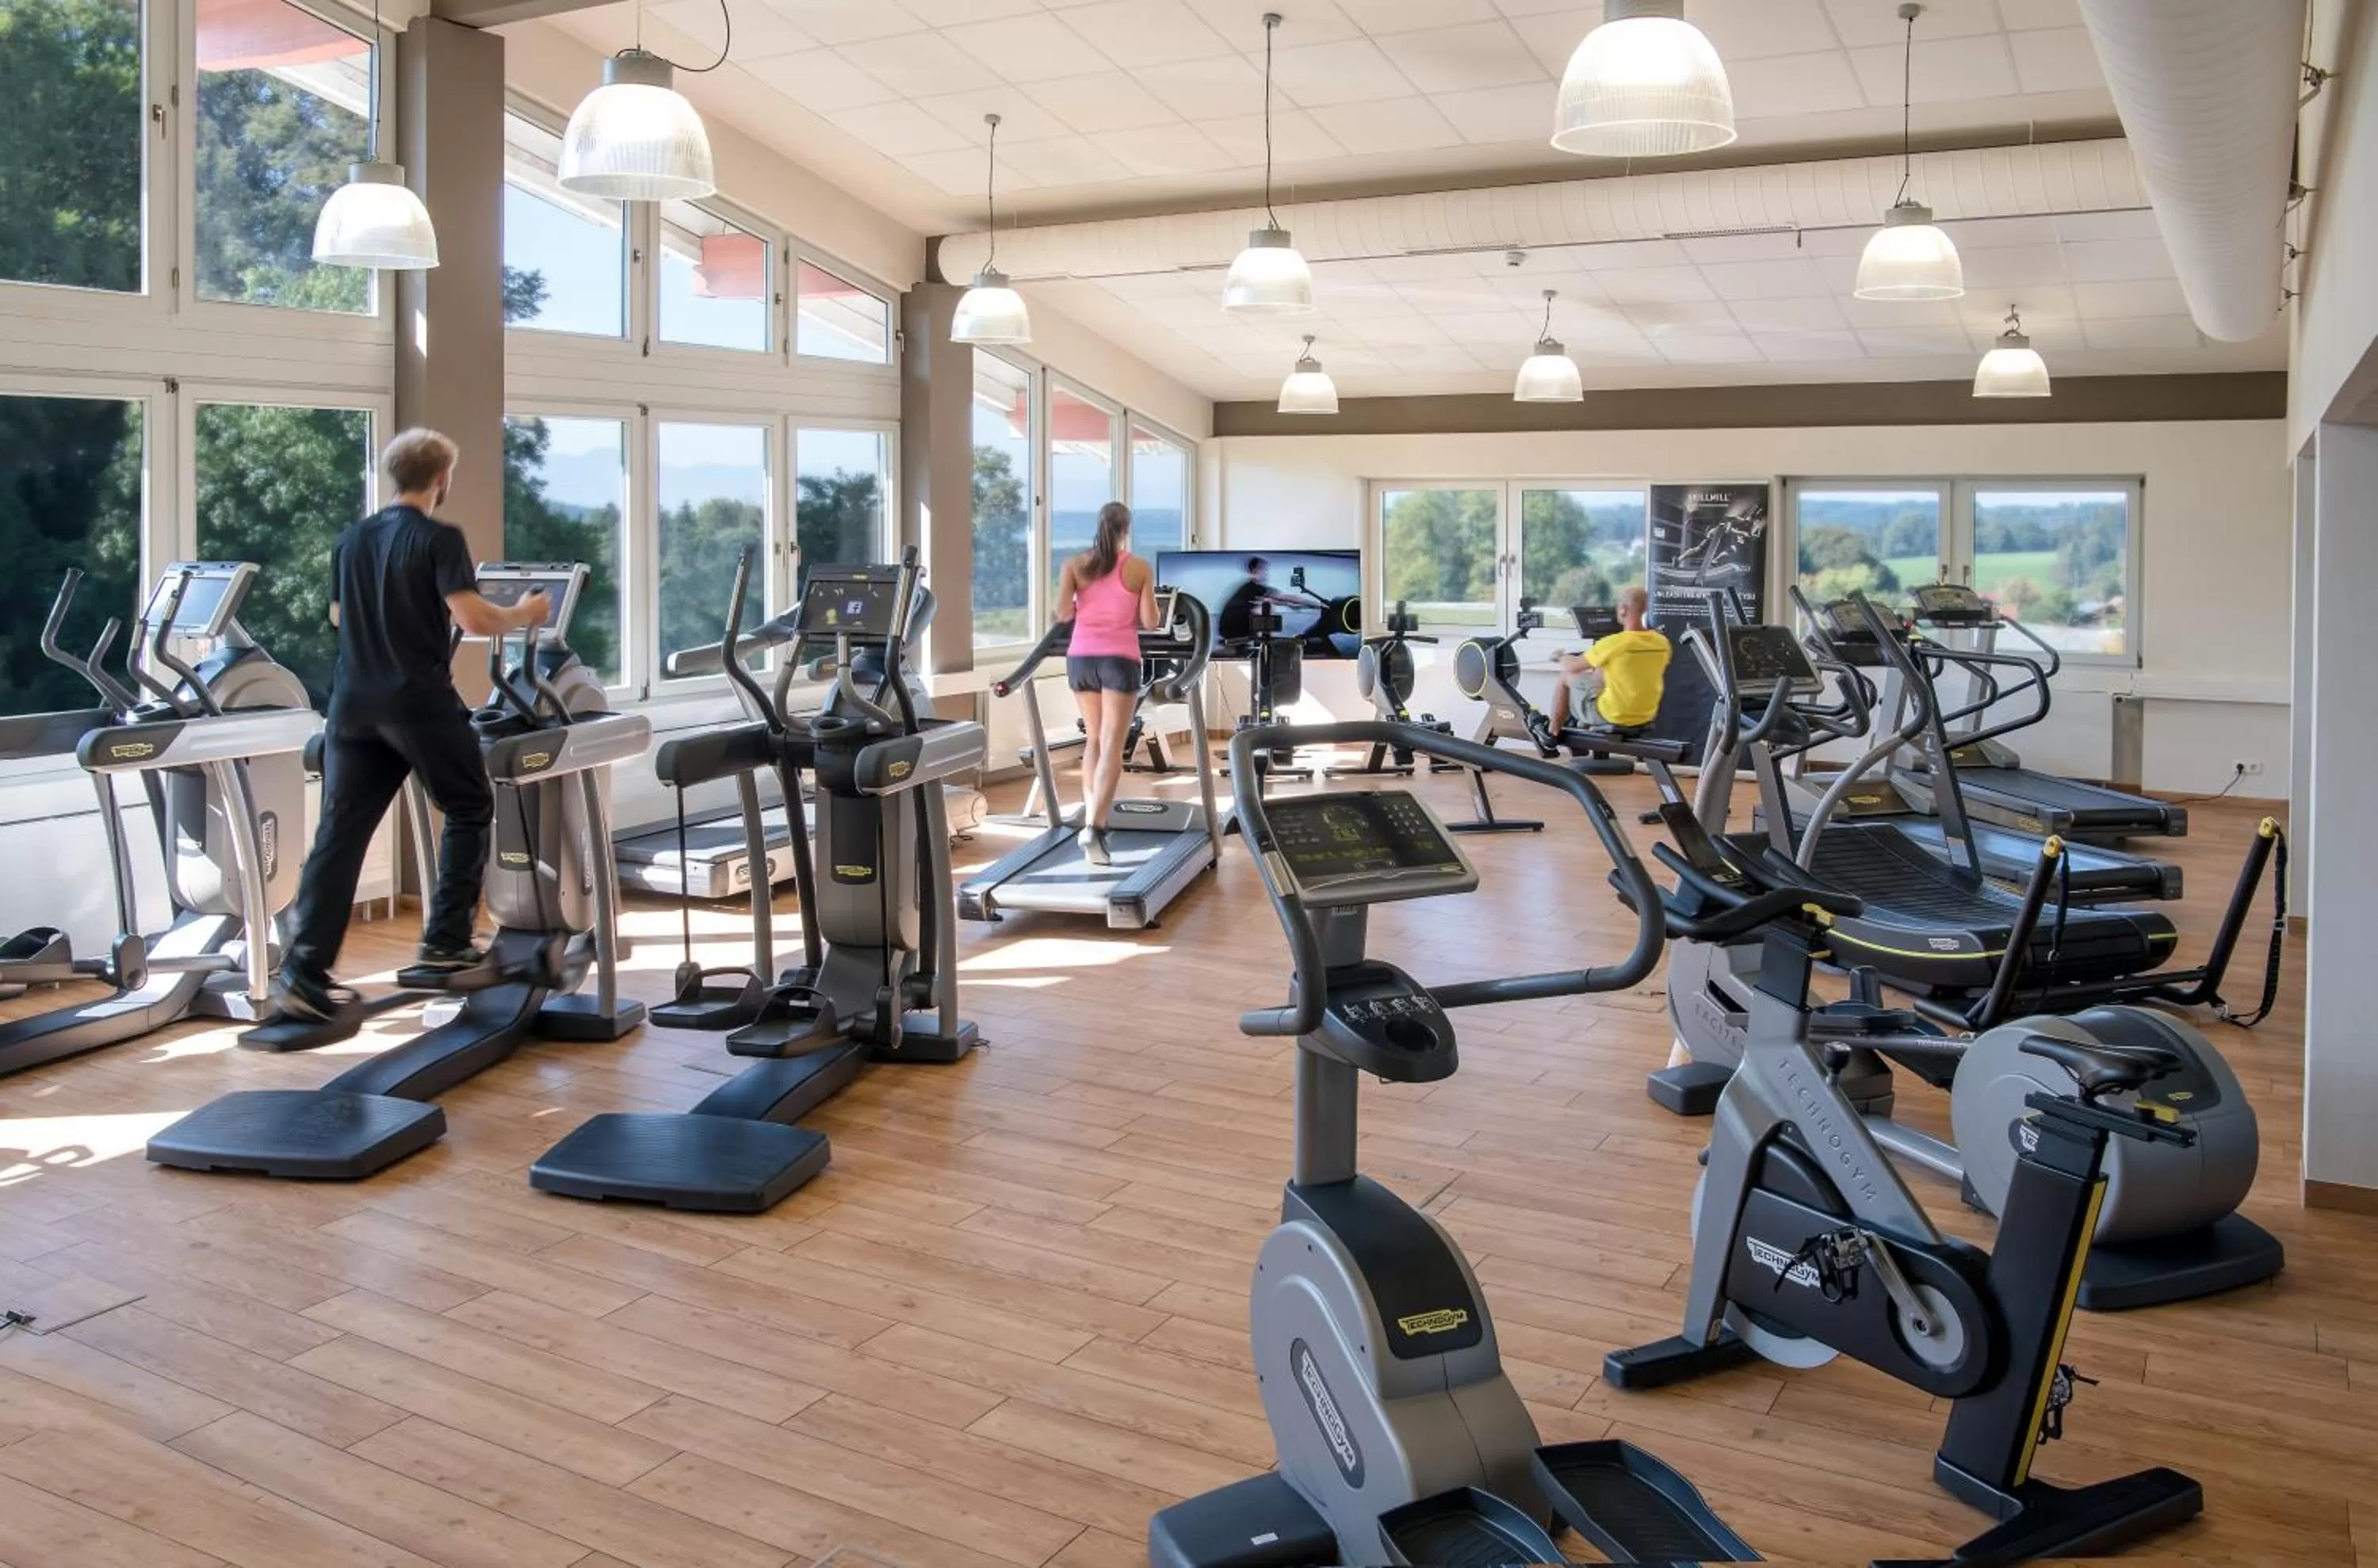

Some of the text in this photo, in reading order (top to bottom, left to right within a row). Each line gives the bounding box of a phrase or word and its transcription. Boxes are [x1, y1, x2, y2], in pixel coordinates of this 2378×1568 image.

[1779, 1058, 1877, 1202] TECHNOGYM
[1397, 1309, 1467, 1336] TECHNOGYM
[1301, 1348, 1356, 1471] TECHNOGYM
